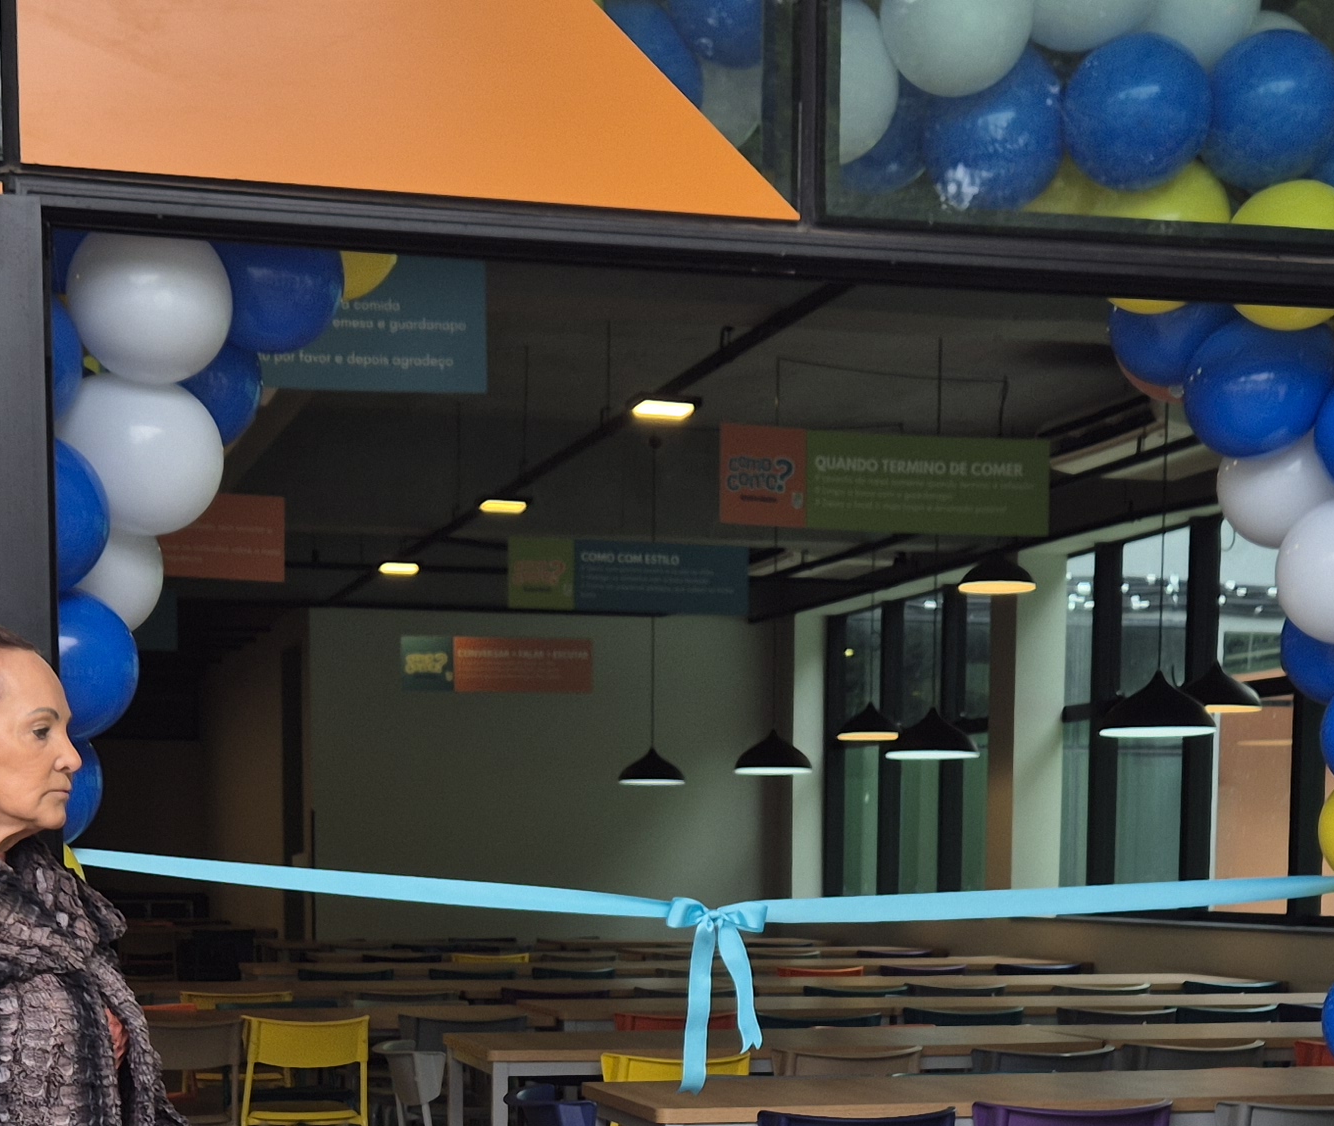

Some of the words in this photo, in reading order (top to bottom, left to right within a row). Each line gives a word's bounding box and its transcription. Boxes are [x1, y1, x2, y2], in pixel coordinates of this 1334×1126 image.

[353, 298, 400, 312] comida
[331, 319, 374, 330] emesa
[377, 320, 386, 330] e
[389, 319, 467, 335] guardanapo
[299, 350, 331, 364] favor
[334, 354, 344, 365] e
[347, 351, 390, 368] depois
[392, 354, 454, 371] agradeço
[815, 455, 879, 473] QUANDO
[882, 459, 946, 476] TERMINO
[949, 461, 967, 476] DE
[970, 461, 1024, 478] COMER
[580, 551, 615, 563] COMO
[617, 552, 643, 564] COM
[644, 553, 680, 566] ESTILO
